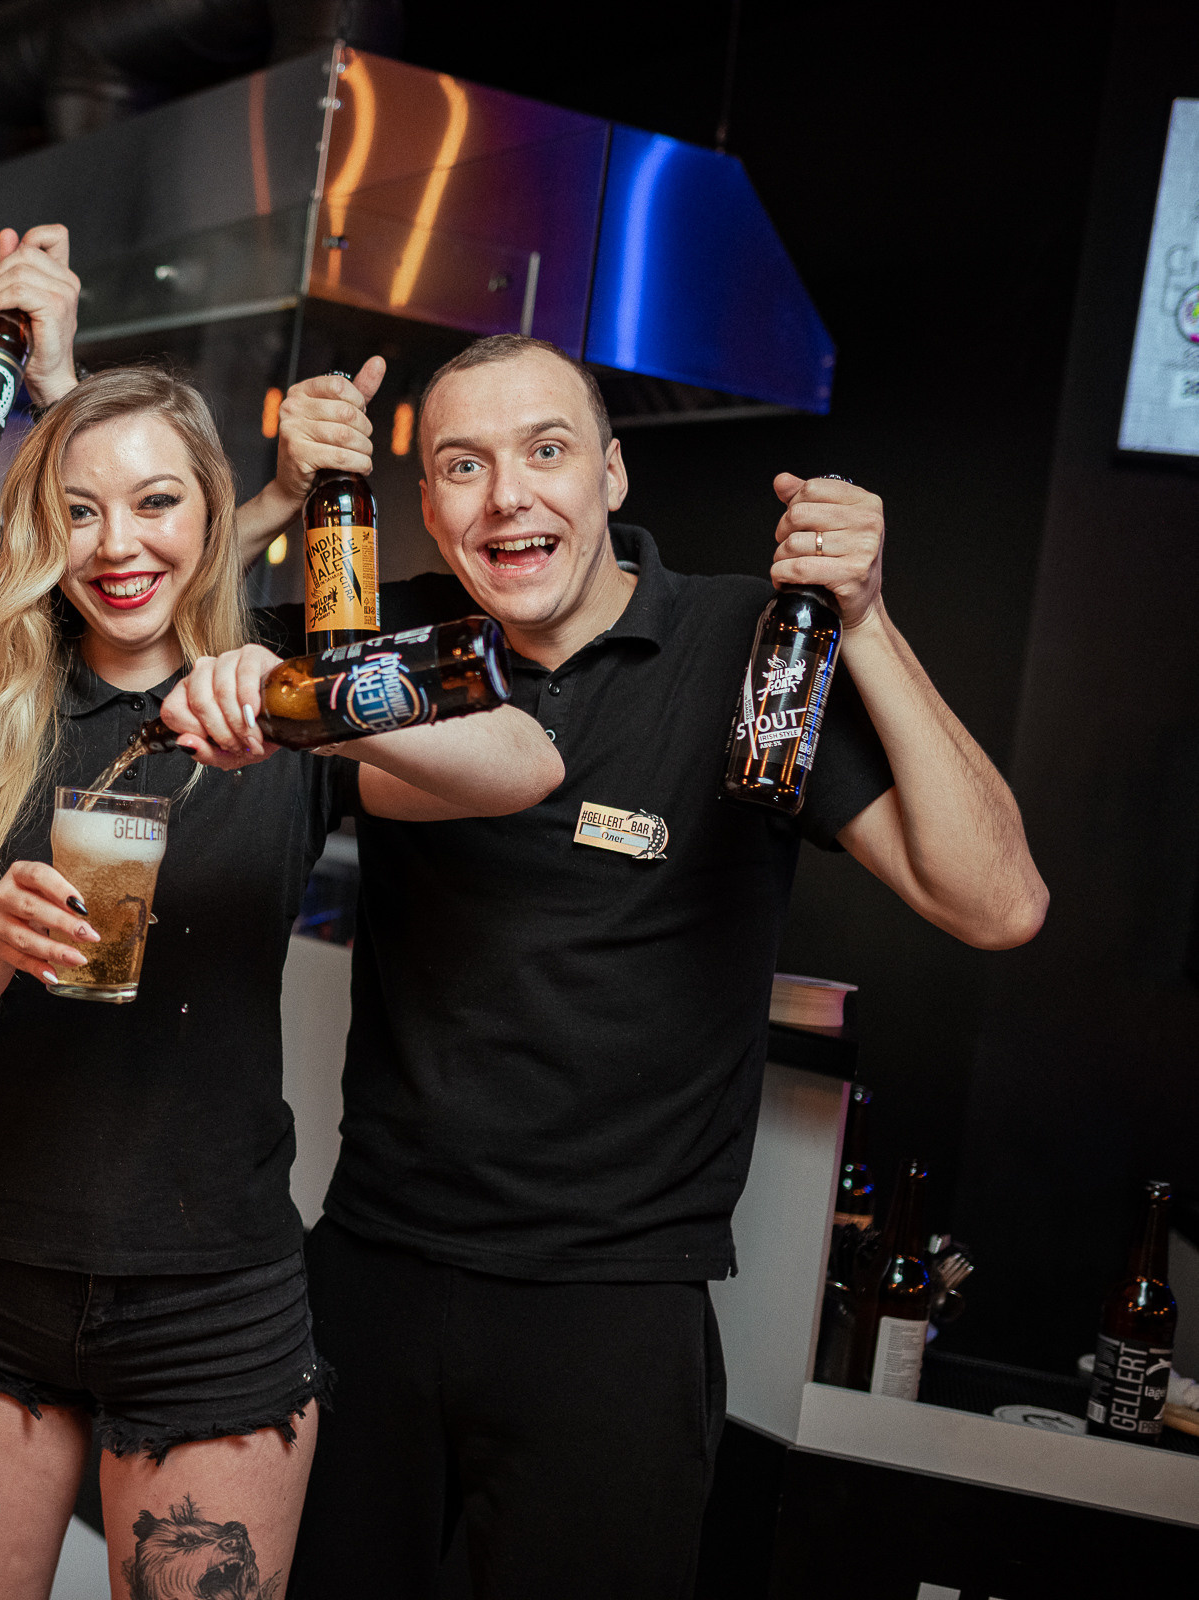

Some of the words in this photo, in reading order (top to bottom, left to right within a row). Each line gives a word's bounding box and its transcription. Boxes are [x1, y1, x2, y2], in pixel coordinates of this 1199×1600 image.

[306, 532, 342, 558] INDIA
[323, 537, 358, 563] PALE
[317, 553, 348, 582] ALE
[339, 575, 355, 602] CITRA
[768, 668, 792, 682] WILD
[768, 677, 793, 692] GOAT
[351, 657, 398, 734] ELLERT
[759, 731, 779, 743] IRISH
[779, 729, 799, 740] STYLE
[1110, 1342, 1147, 1431] GELLERT
